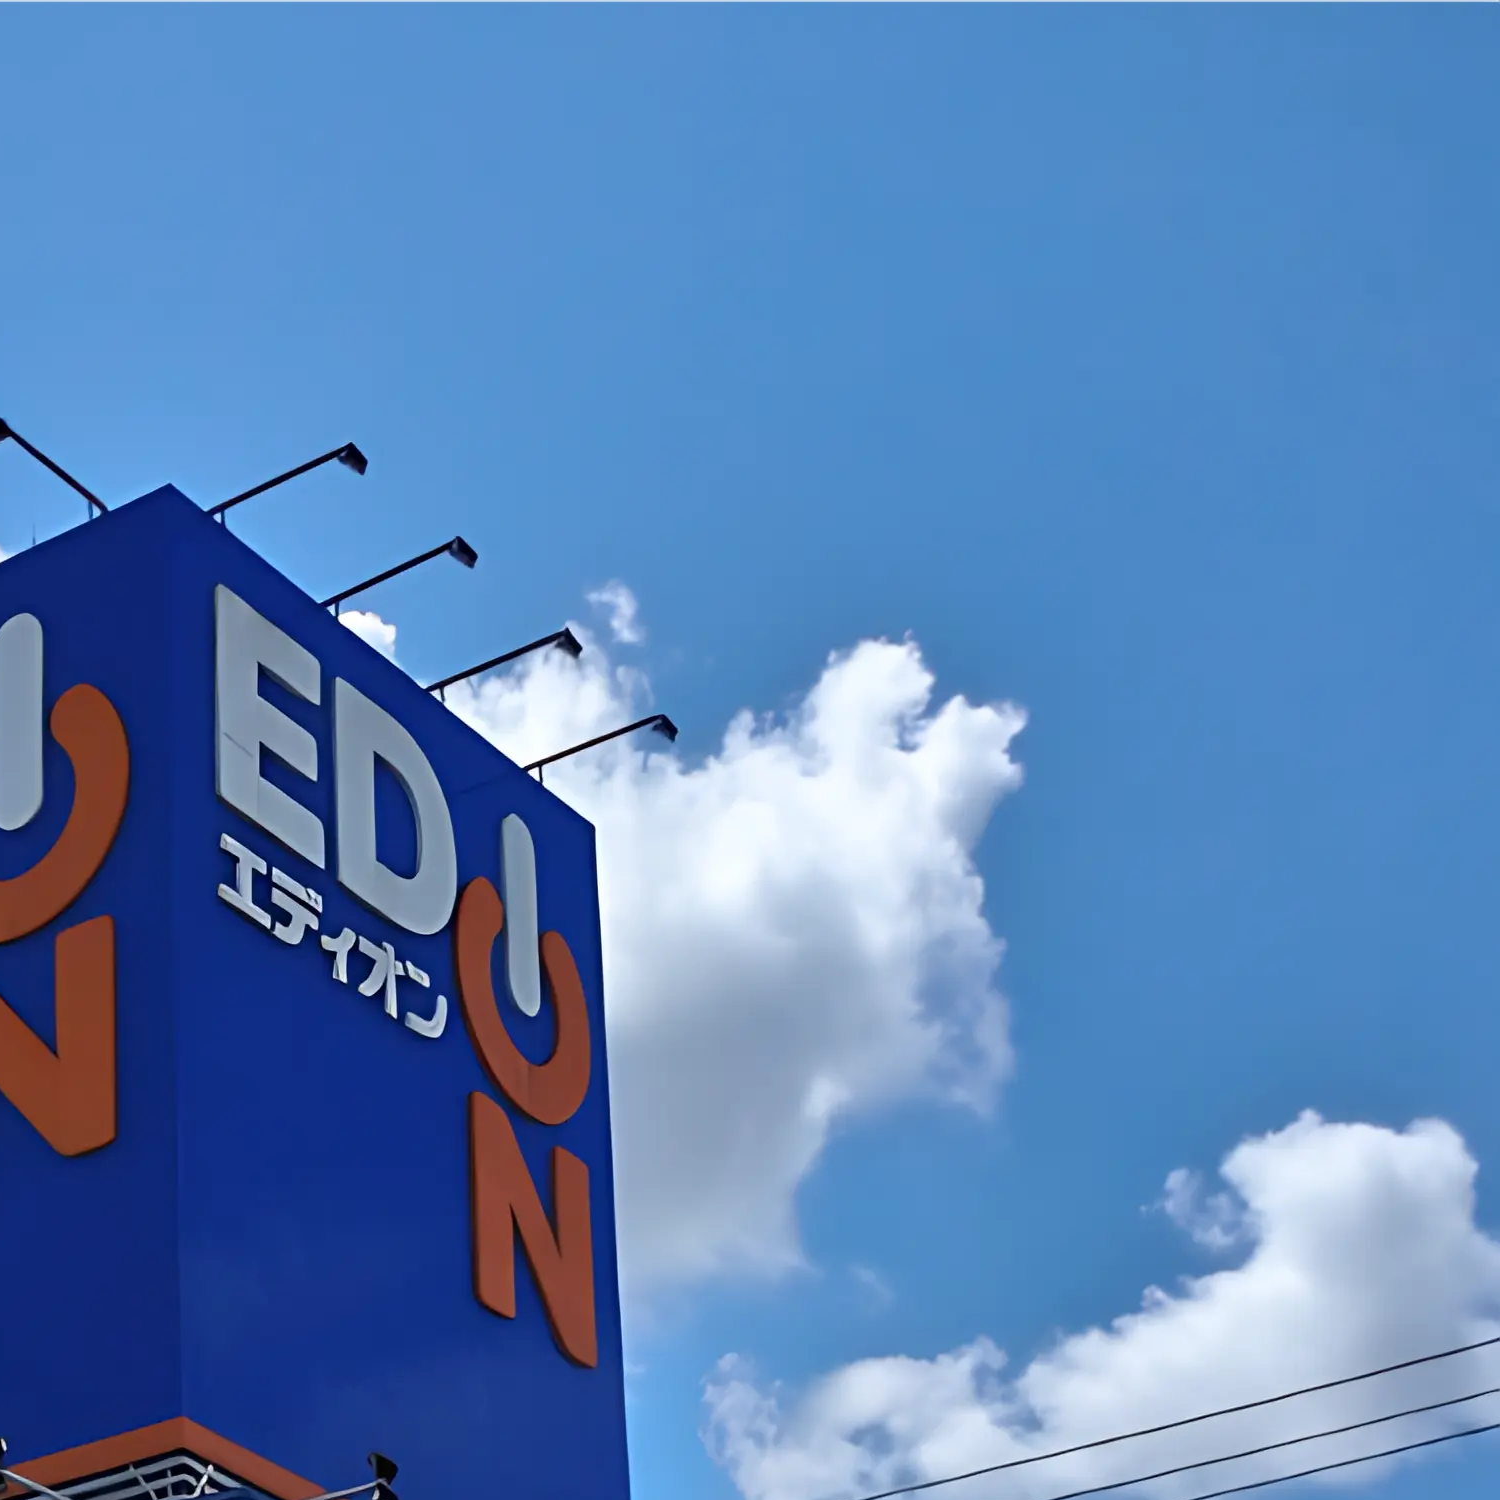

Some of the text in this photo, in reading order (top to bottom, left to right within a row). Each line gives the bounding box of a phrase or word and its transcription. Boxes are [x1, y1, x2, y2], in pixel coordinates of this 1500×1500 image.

[214, 583, 599, 1370] EDION
[217, 833, 449, 1039] エディオン
